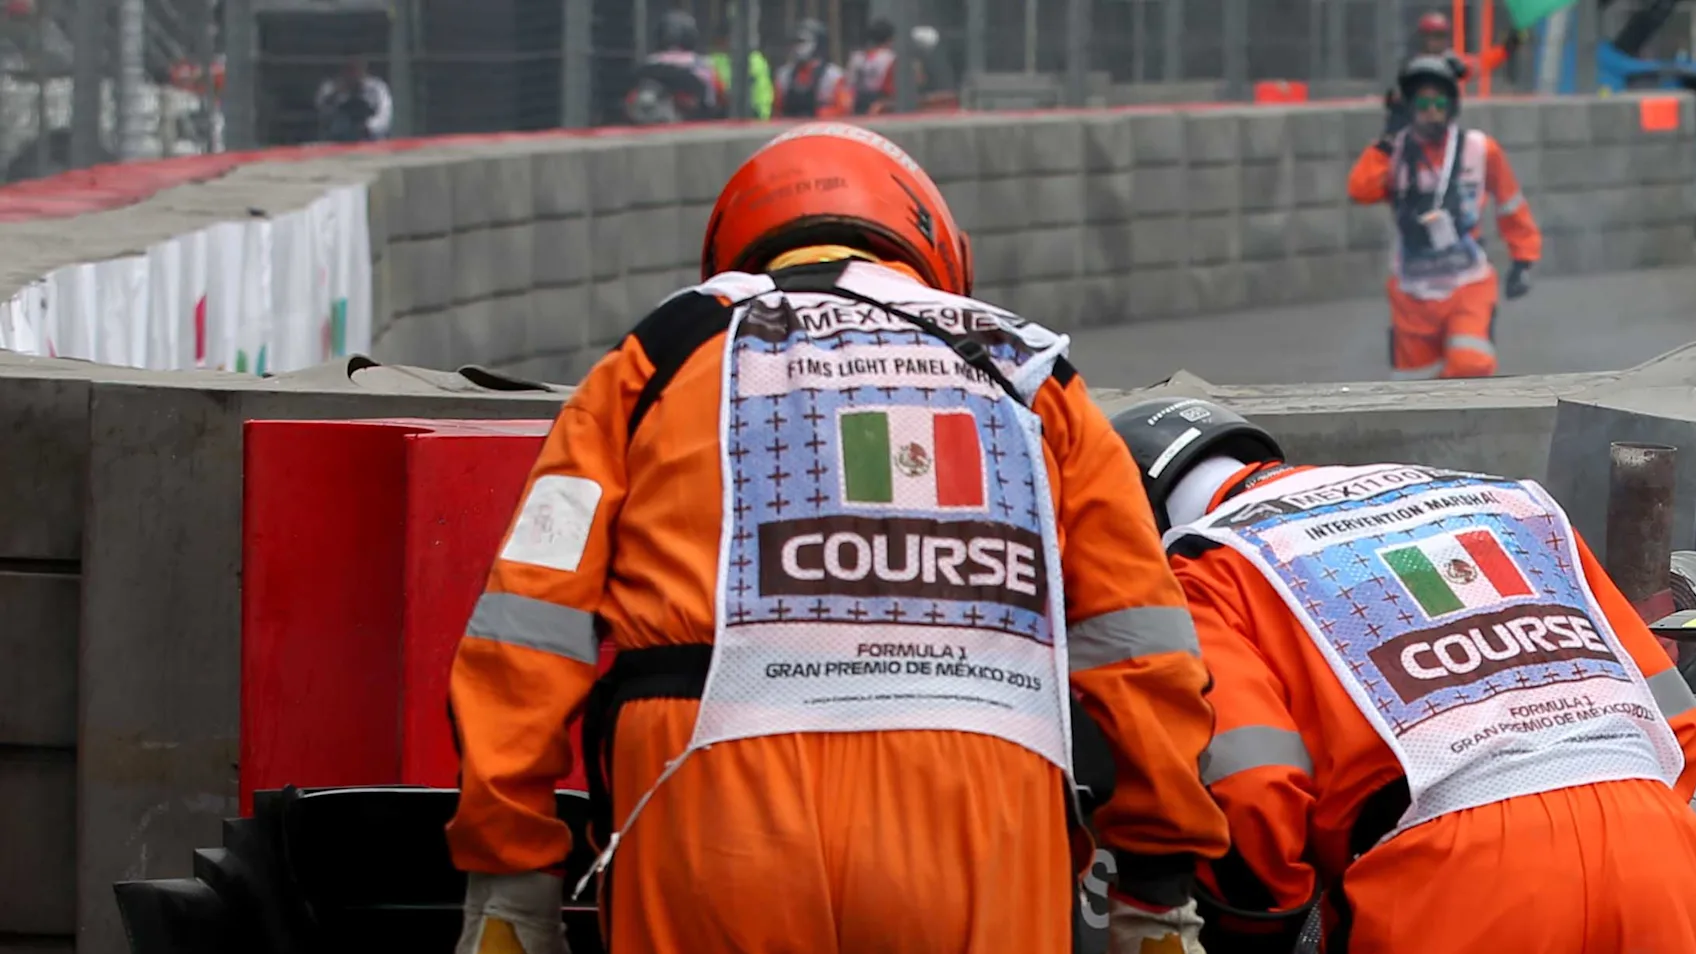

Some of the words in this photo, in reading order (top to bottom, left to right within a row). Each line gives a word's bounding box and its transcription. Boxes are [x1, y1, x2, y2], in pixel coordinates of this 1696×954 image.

[802, 306, 959, 332] MEX159
[838, 358, 888, 377] LIGHT
[894, 357, 949, 376] PANEL
[1305, 506, 1425, 541] INTERVENTION
[781, 532, 1038, 596] COURSE
[857, 643, 954, 658] FORMULA
[958, 646, 967, 661] 1
[1400, 614, 1611, 680] COURSE
[766, 662, 821, 678] GRAN
[825, 661, 901, 677] PREMIO
[906, 660, 931, 675] DE
[1509, 697, 1583, 719] FORMULA
[1583, 695, 1596, 709] 1
[1450, 725, 1498, 754] GRAN
[1500, 714, 1553, 734] PREMIO
[1553, 711, 1576, 729] DE
